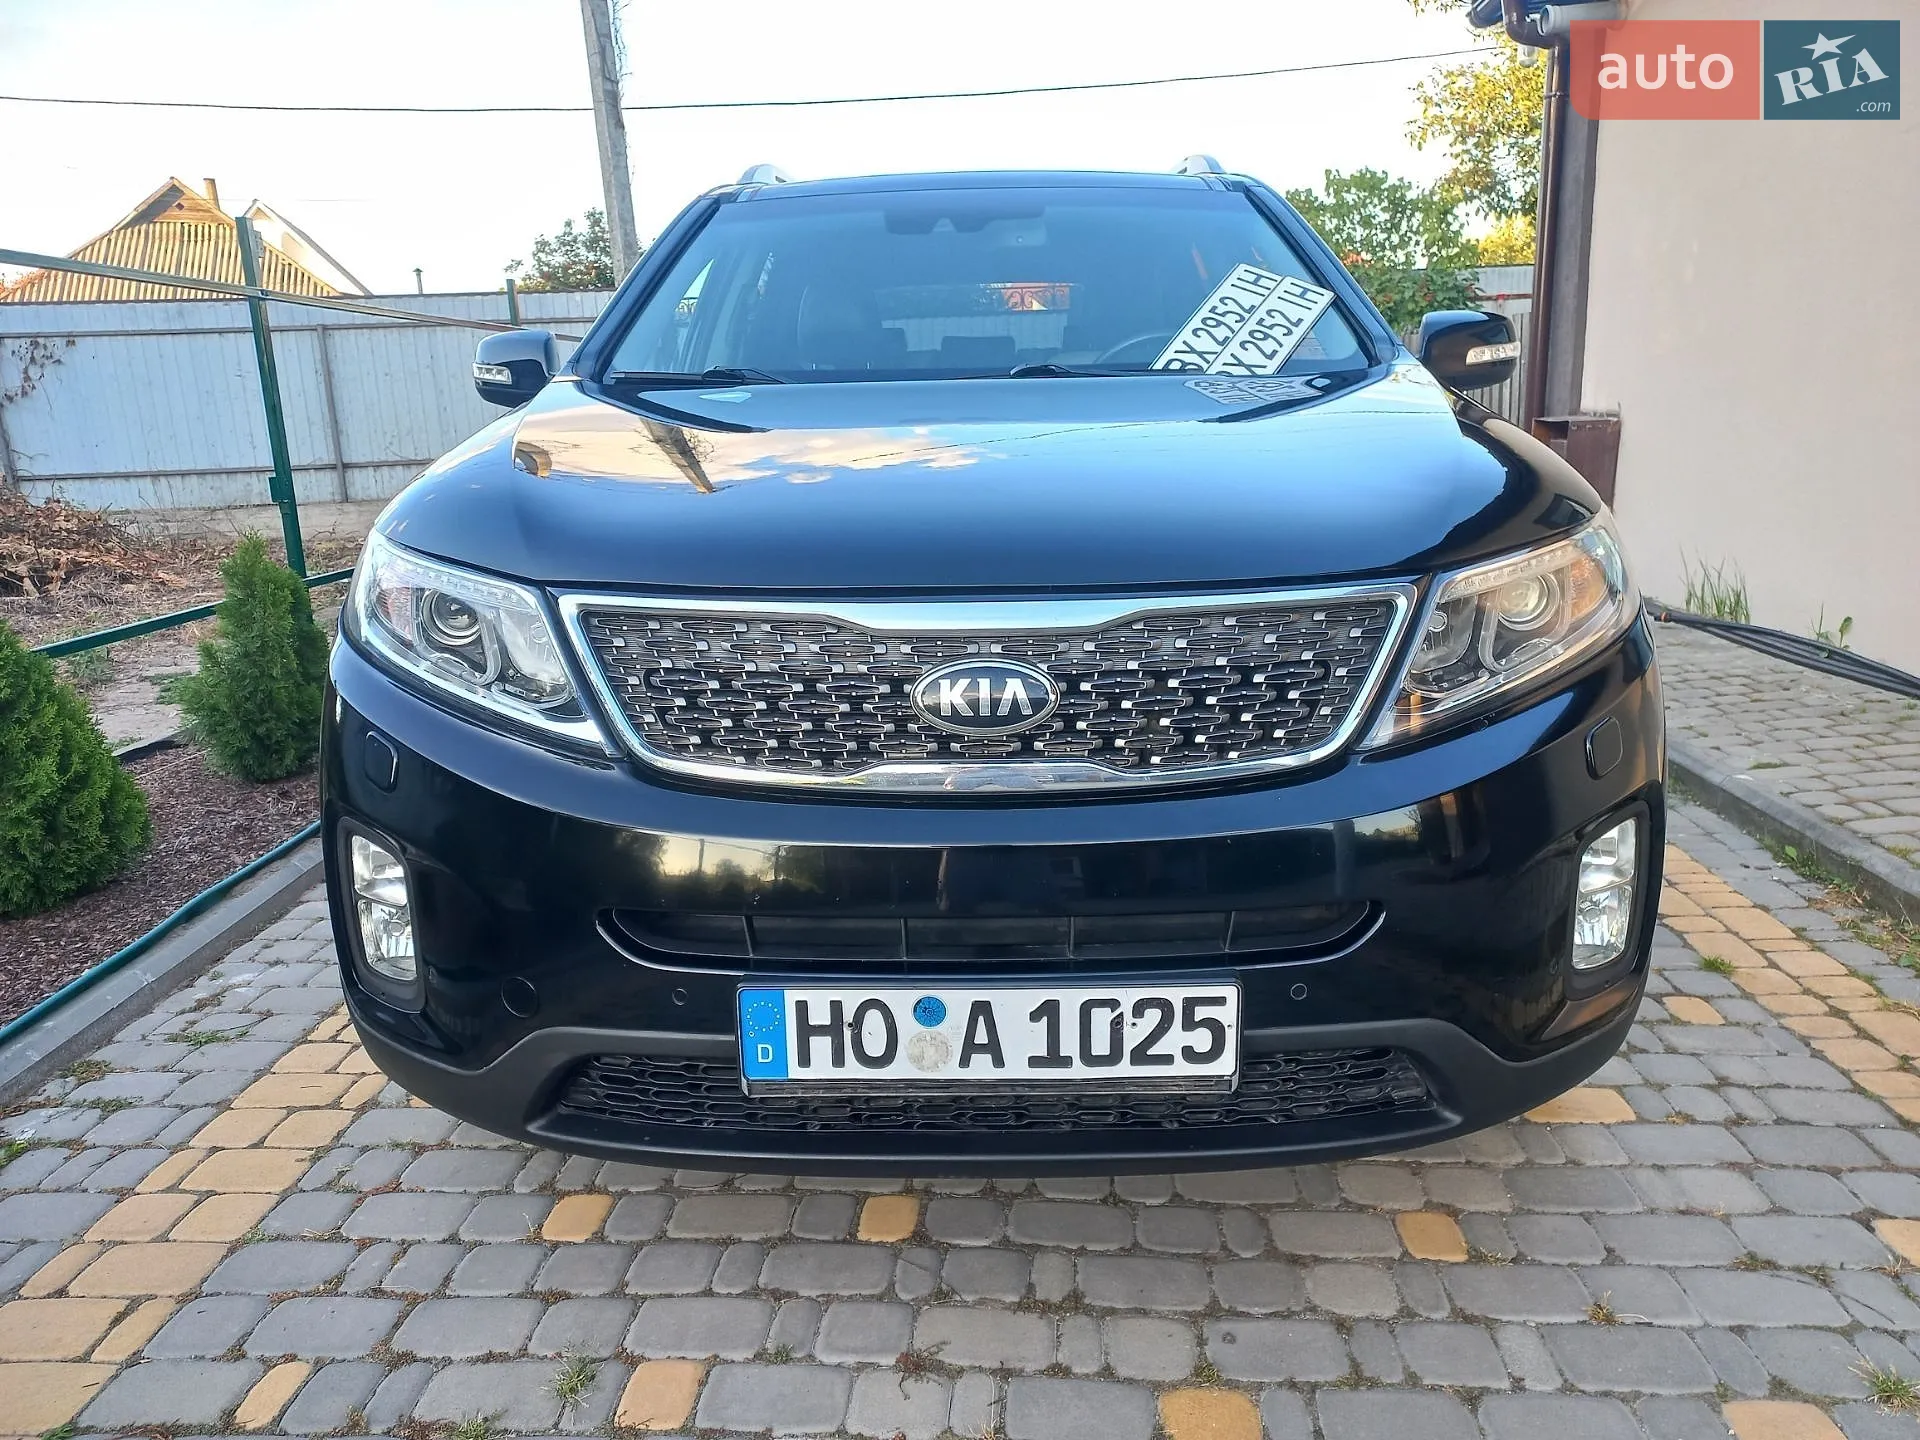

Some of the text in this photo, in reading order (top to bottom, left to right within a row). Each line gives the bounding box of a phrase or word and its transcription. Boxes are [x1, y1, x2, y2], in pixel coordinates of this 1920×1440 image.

[1191, 296, 1257, 346] 2952
[1230, 269, 1278, 297] IH
[1215, 282, 1325, 376] X 2952 IH
[938, 678, 1034, 716] KIA
[757, 1044, 774, 1063] D
[795, 998, 899, 1070] HO
[959, 1000, 1006, 1070] A
[1028, 997, 1228, 1069] 1025
